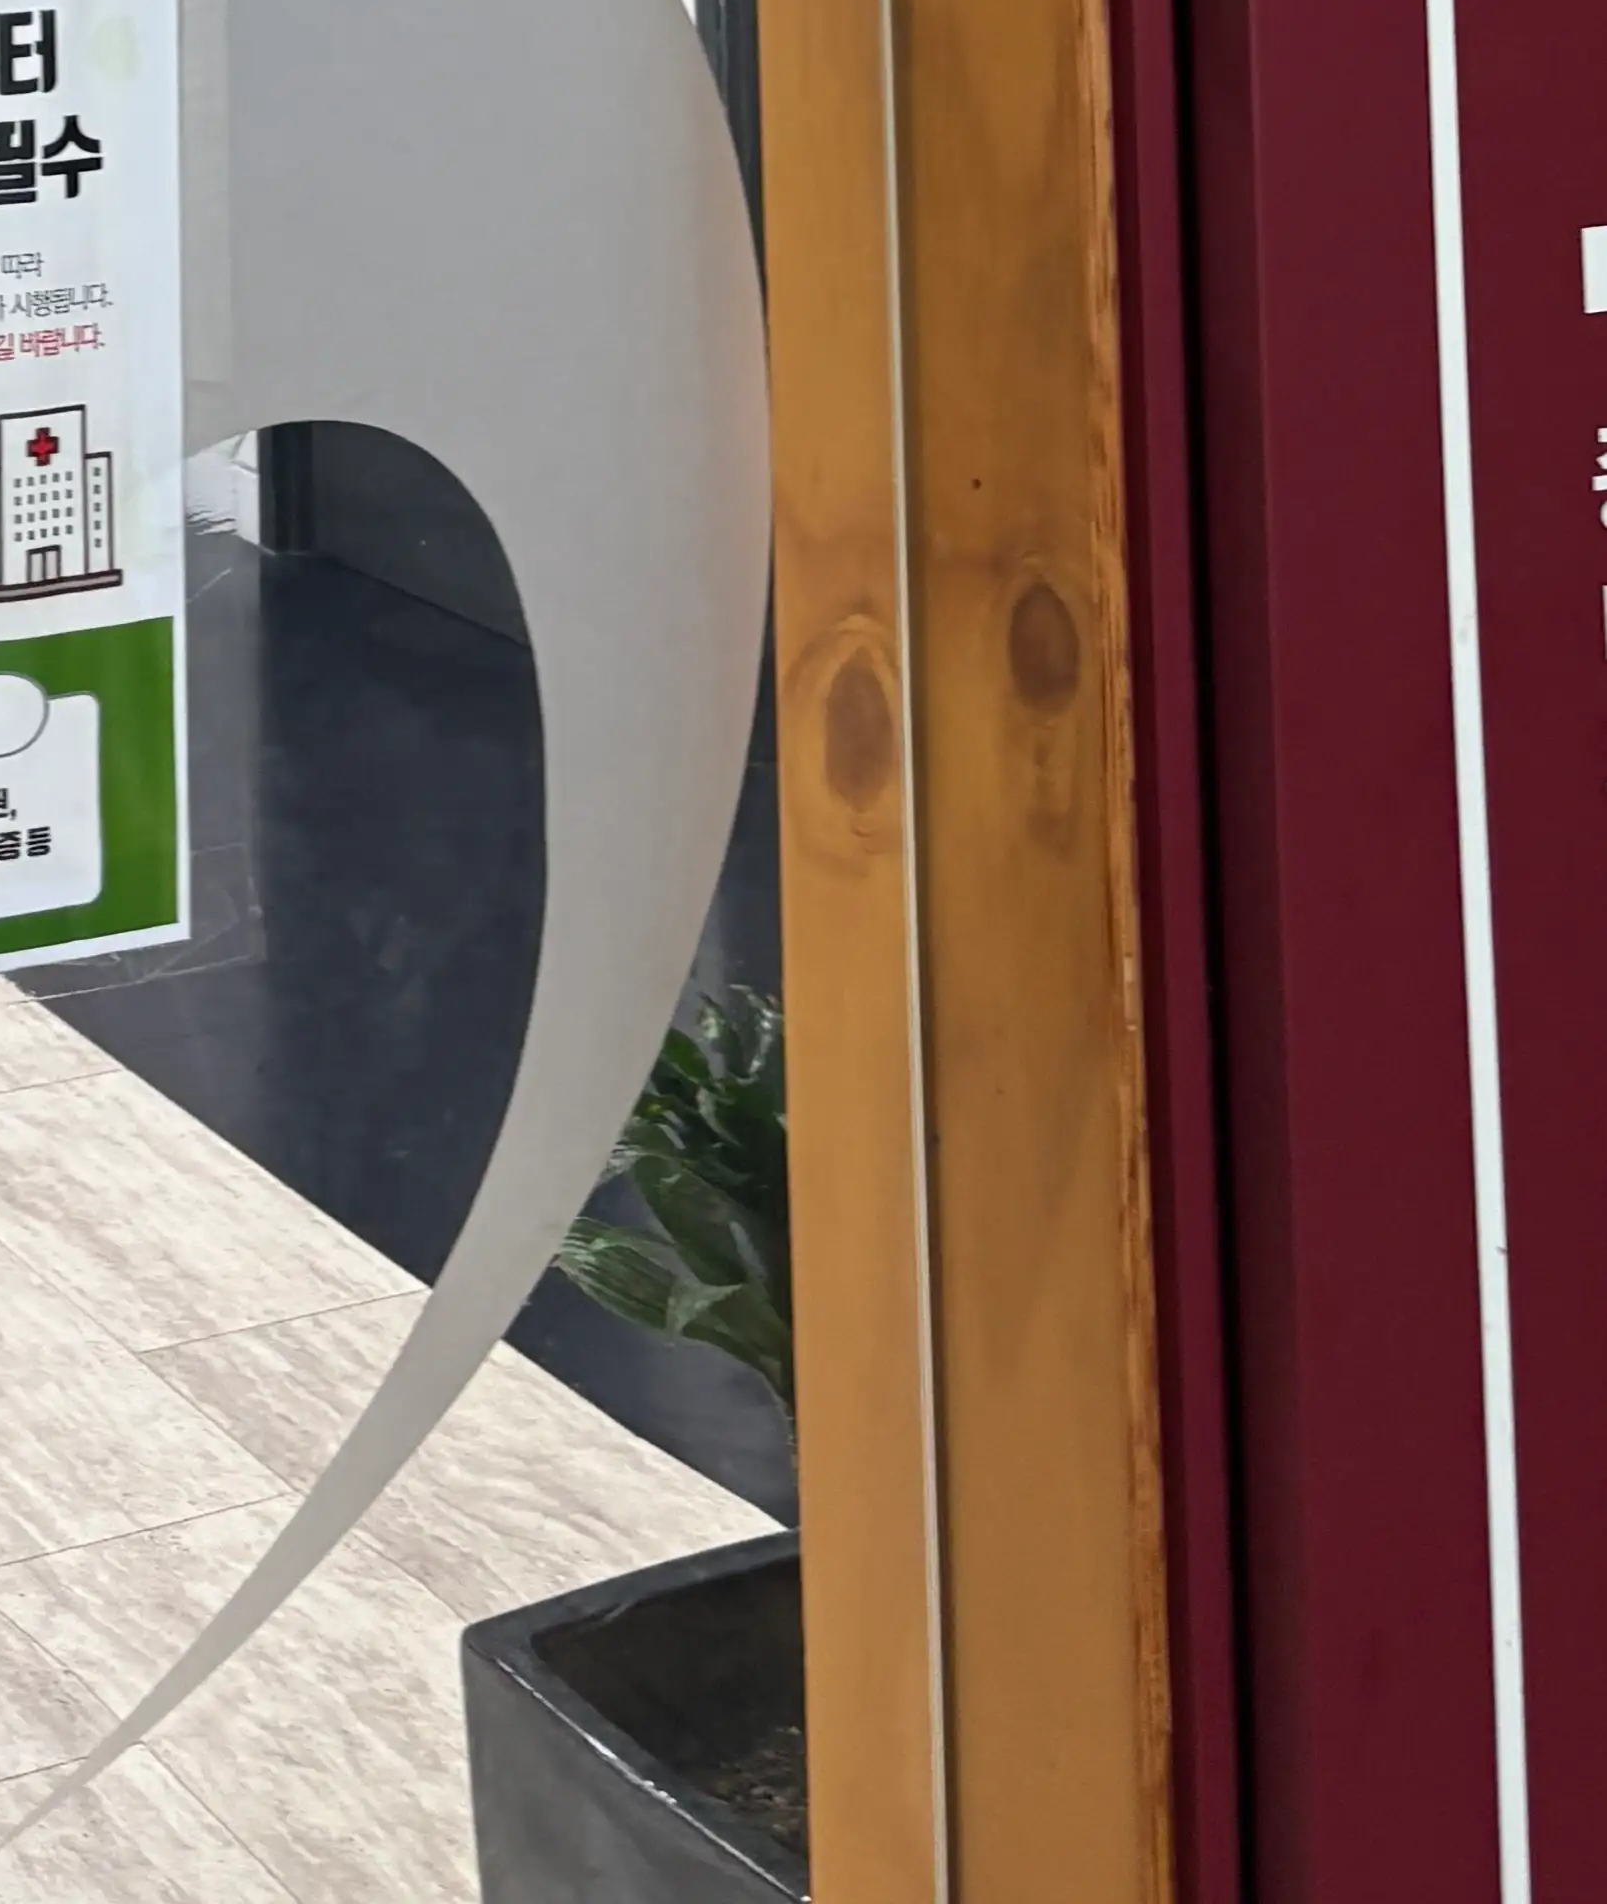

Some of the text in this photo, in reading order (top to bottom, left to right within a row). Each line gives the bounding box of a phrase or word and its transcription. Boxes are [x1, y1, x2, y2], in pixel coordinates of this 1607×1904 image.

[0, 251, 45, 279] 따라
[10, 282, 114, 318] 시행됩니다.
[18, 321, 106, 358] 바랍니다.
[25, 825, 53, 859] 등
